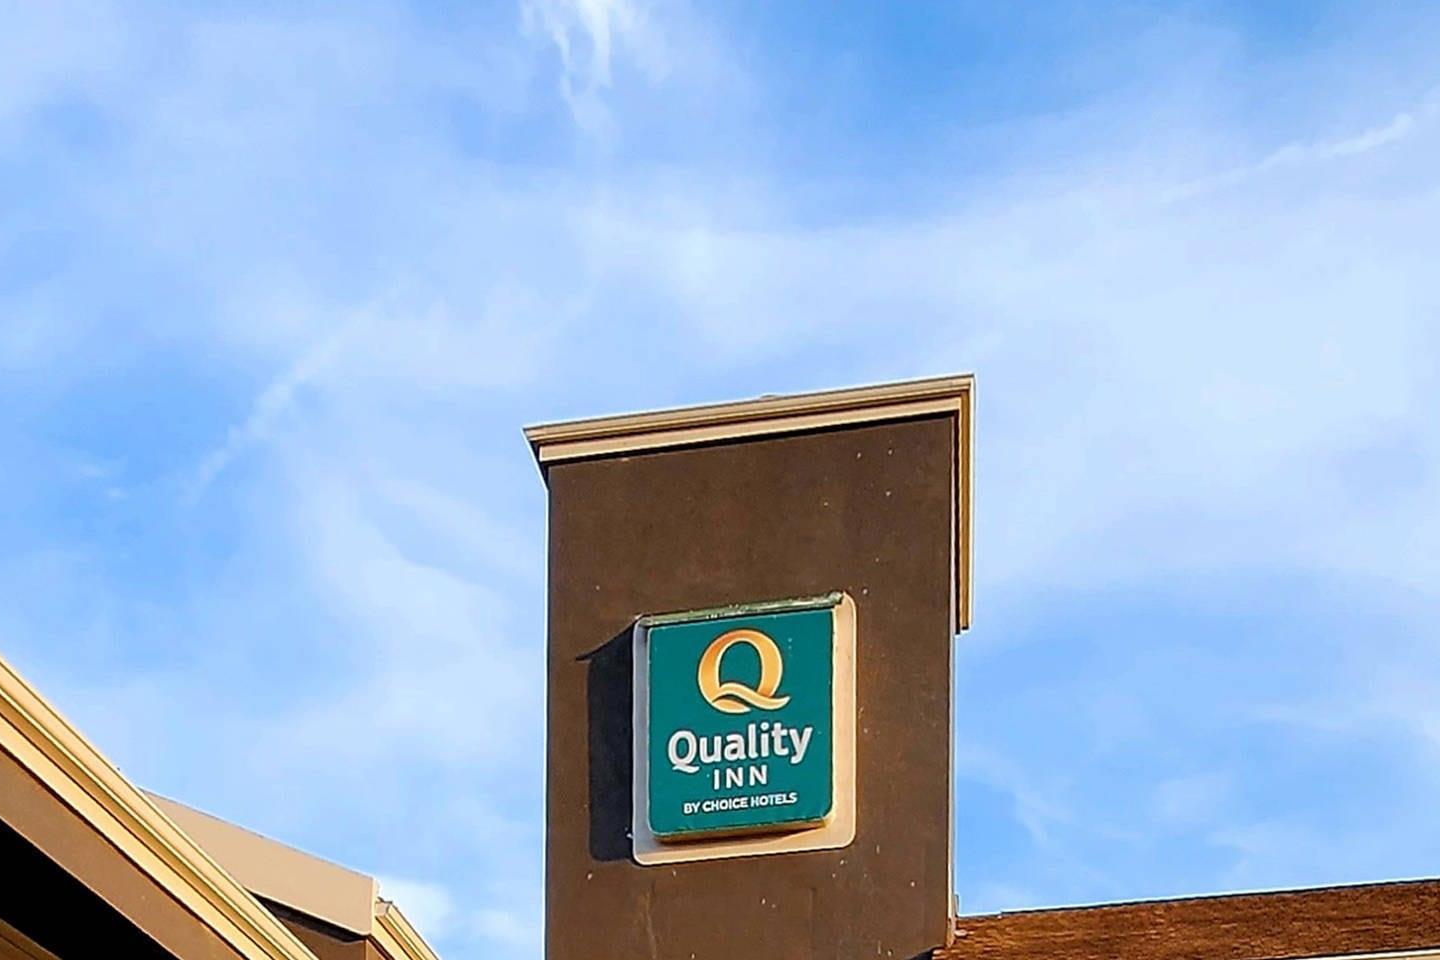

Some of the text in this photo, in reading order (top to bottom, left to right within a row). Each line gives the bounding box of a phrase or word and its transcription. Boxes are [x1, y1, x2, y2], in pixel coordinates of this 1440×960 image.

[698, 629, 791, 714] Q
[667, 721, 814, 774] Quality
[713, 764, 768, 791] INN
[683, 792, 798, 815] BY CHOICE HOTELS
